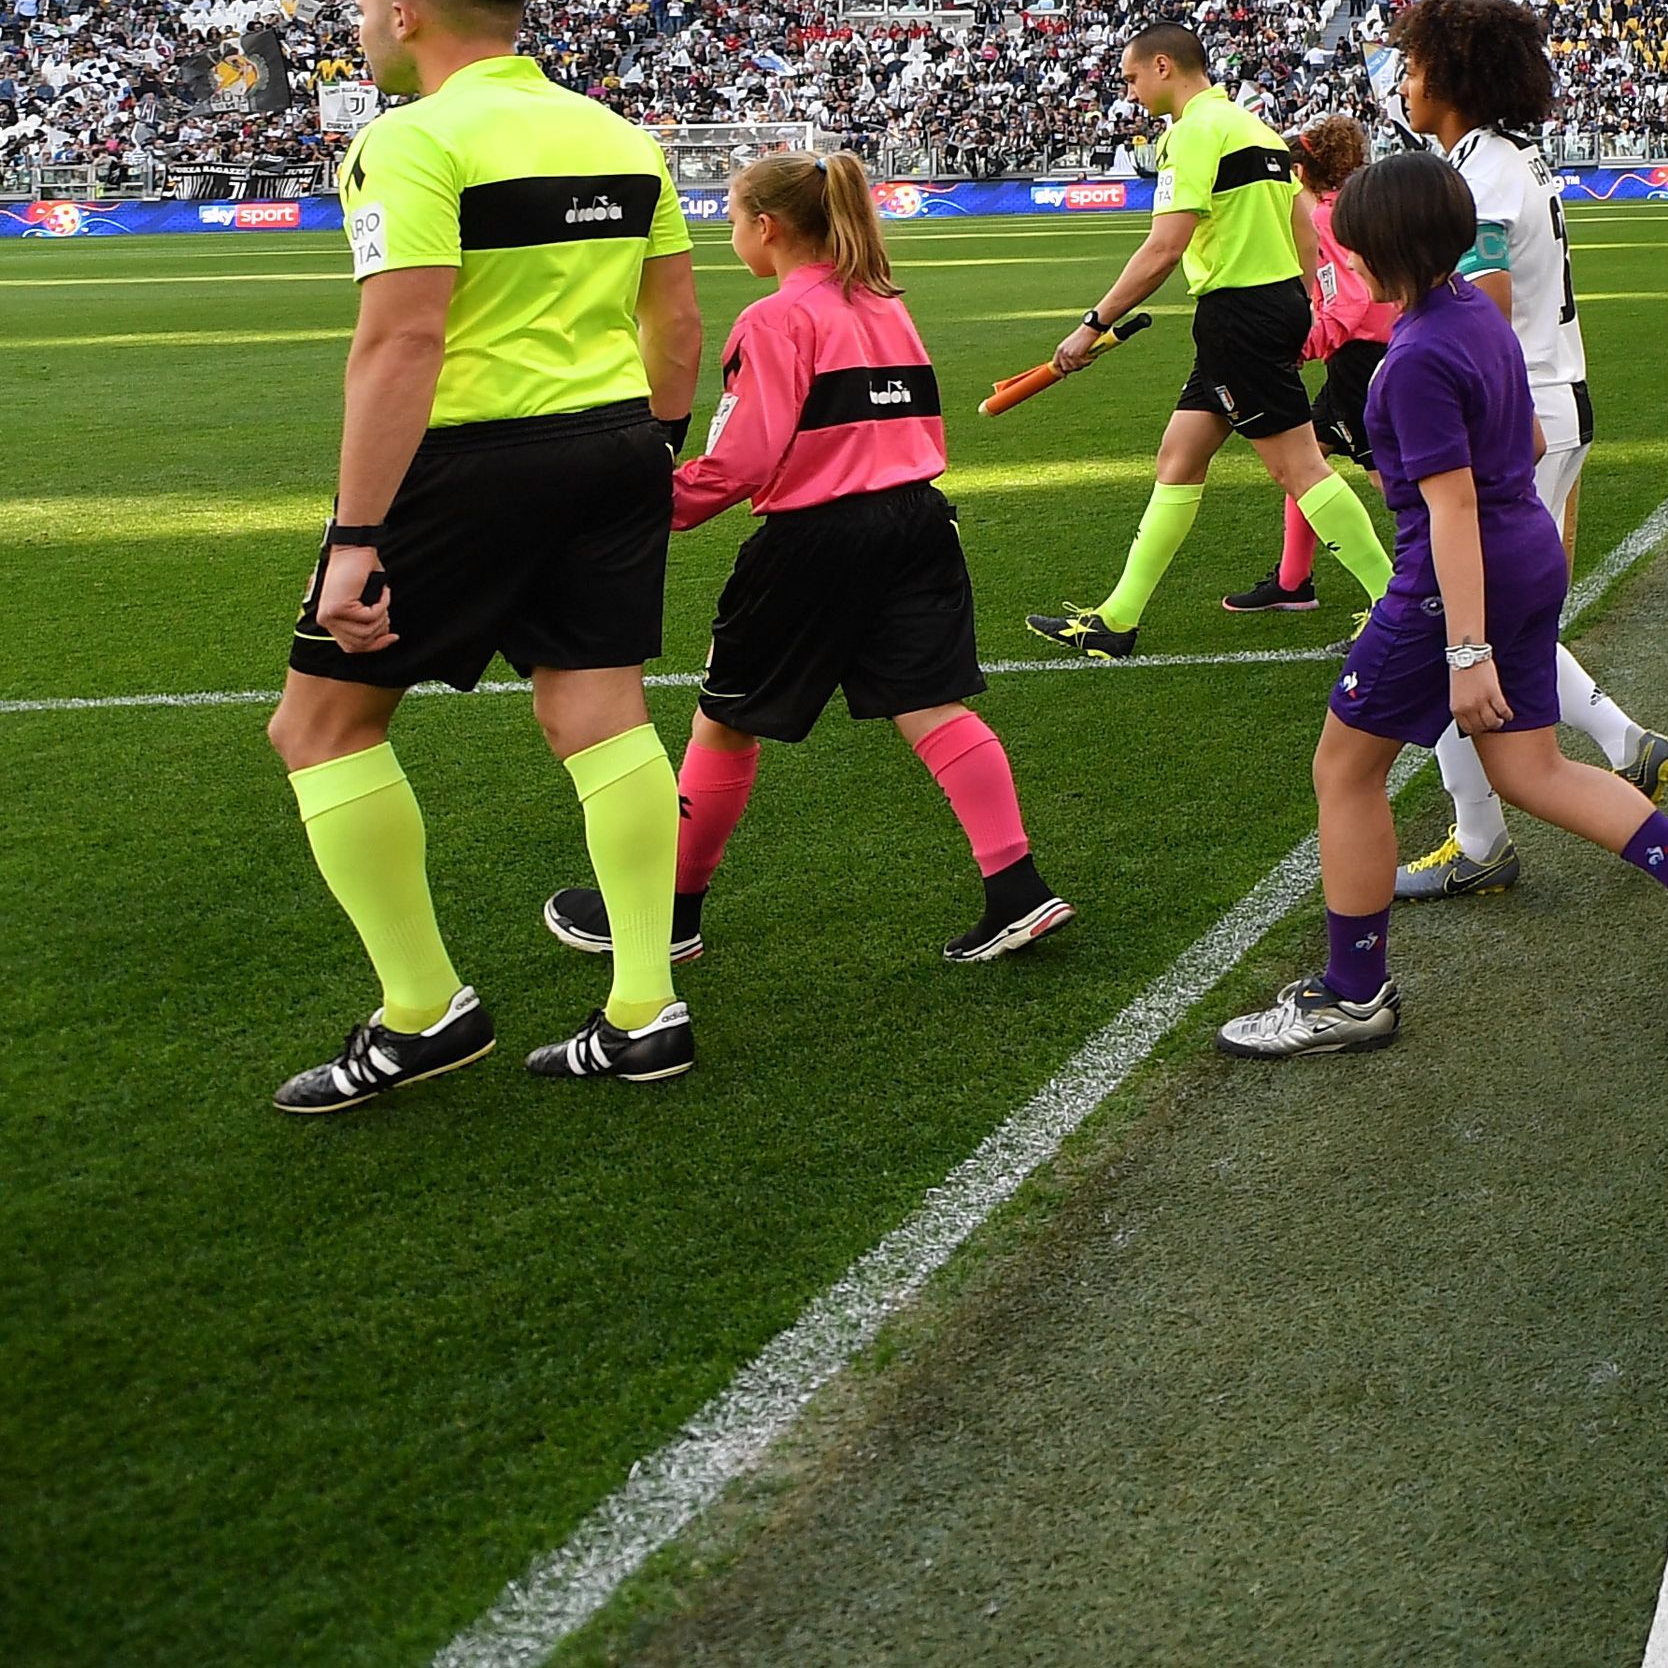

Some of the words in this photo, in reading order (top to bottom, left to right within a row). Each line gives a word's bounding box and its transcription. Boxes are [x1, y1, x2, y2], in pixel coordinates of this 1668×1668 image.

[1034, 187, 1066, 208] sky
[1070, 186, 1120, 208] sport
[201, 207, 236, 226] sky
[240, 204, 294, 226] sport
